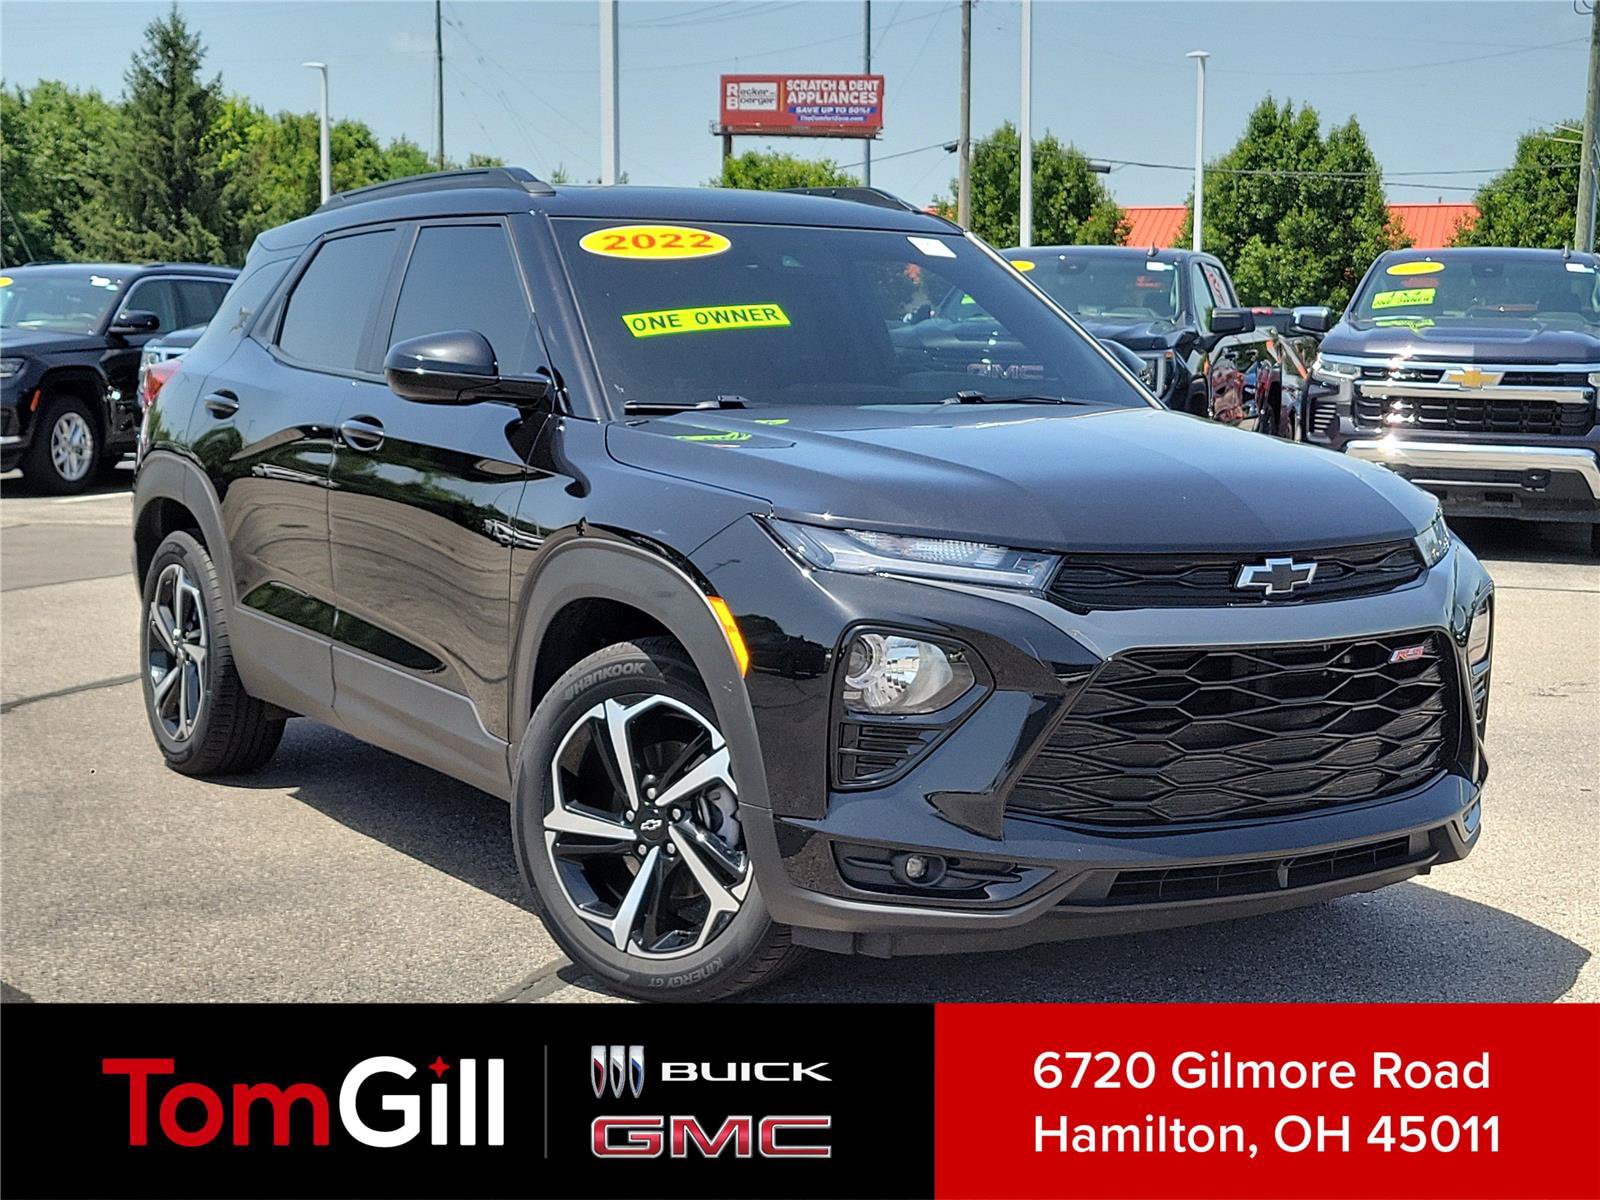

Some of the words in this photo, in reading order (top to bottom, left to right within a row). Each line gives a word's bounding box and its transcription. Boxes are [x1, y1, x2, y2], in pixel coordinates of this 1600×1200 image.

[786, 80, 837, 91] SCRATCH
[838, 80, 847, 91] &
[849, 80, 879, 91] DENT
[787, 92, 878, 104] APPLIANCES
[602, 233, 715, 251] 2022
[631, 315, 683, 332] ONE
[694, 308, 781, 326] OWNER
[967, 363, 1044, 380] GMC
